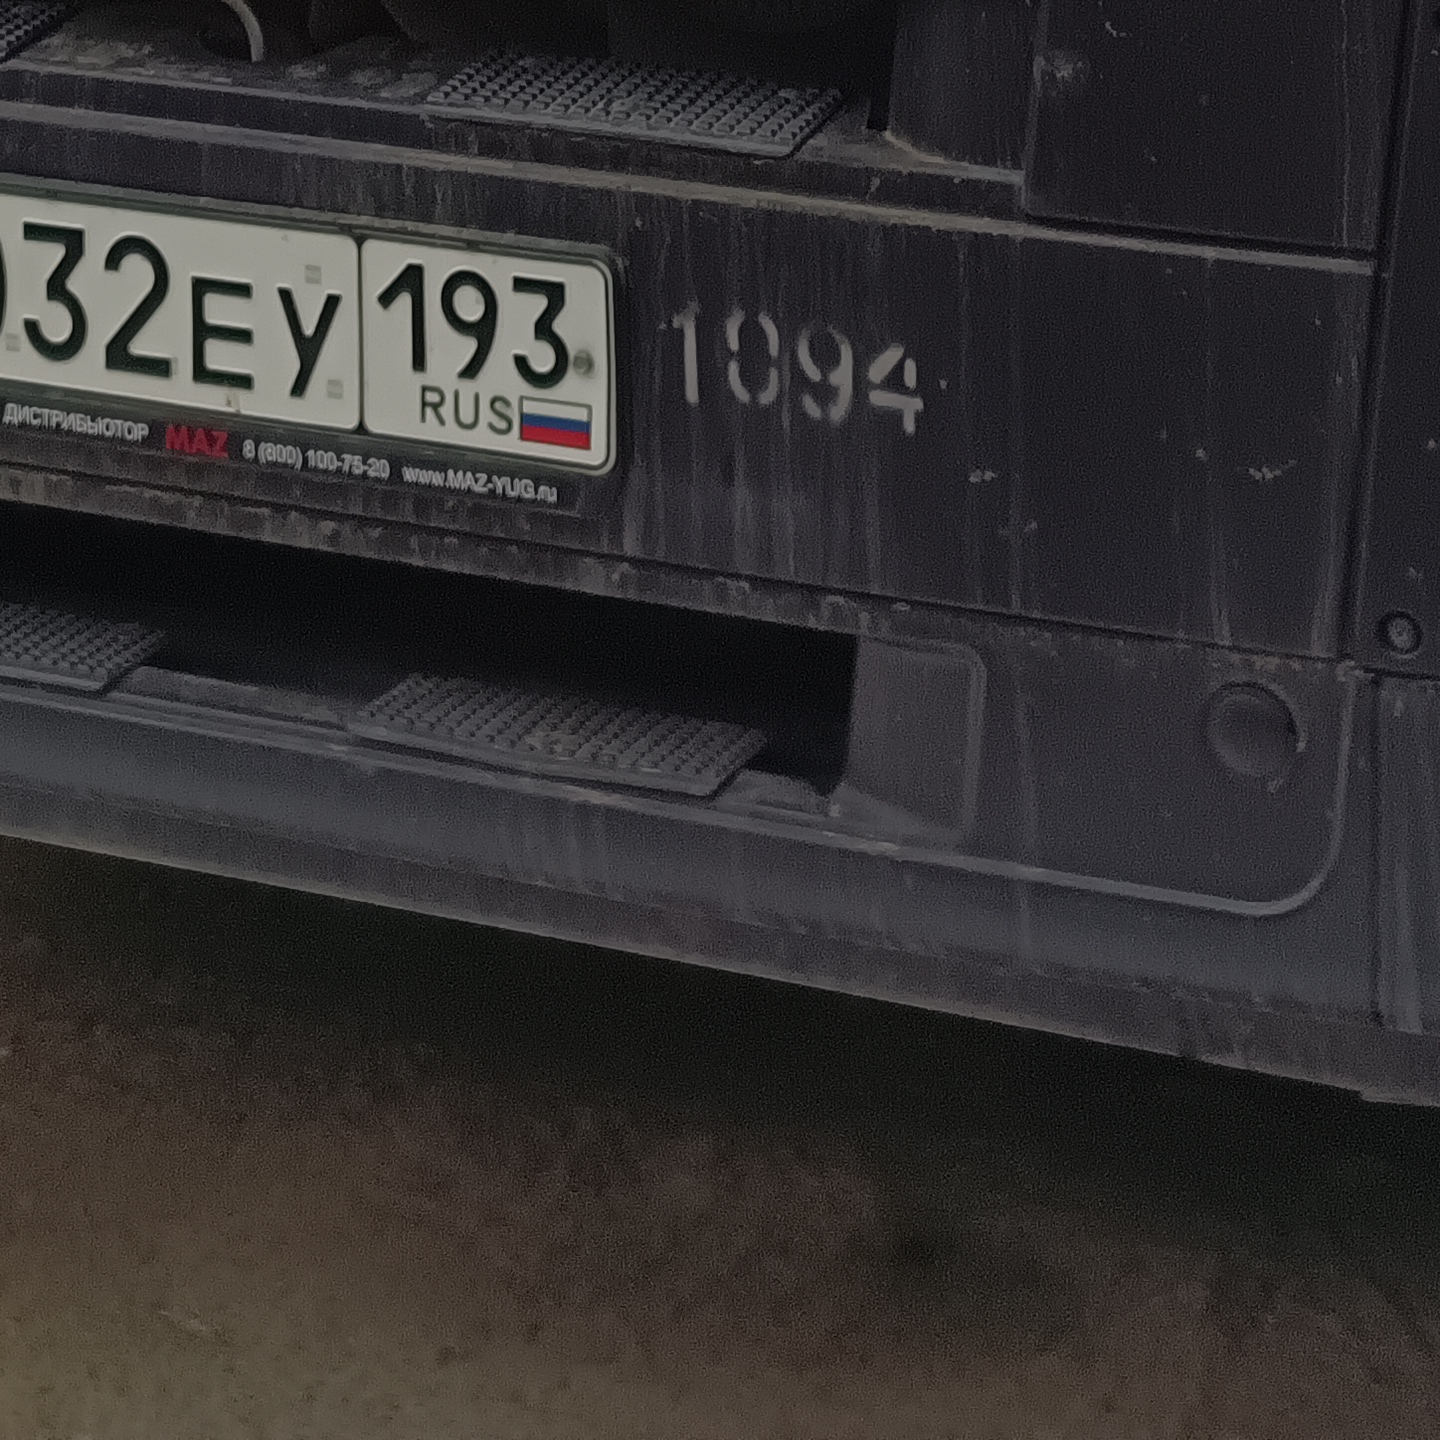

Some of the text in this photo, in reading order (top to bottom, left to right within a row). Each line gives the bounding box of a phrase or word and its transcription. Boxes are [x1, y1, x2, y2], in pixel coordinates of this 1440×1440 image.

[377, 261, 568, 389] 193
[672, 302, 923, 435] 1094
[3, 403, 150, 443] ДИСТРИБЬЮТОР
[165, 424, 229, 459] MAZ
[419, 385, 515, 437] RUS
